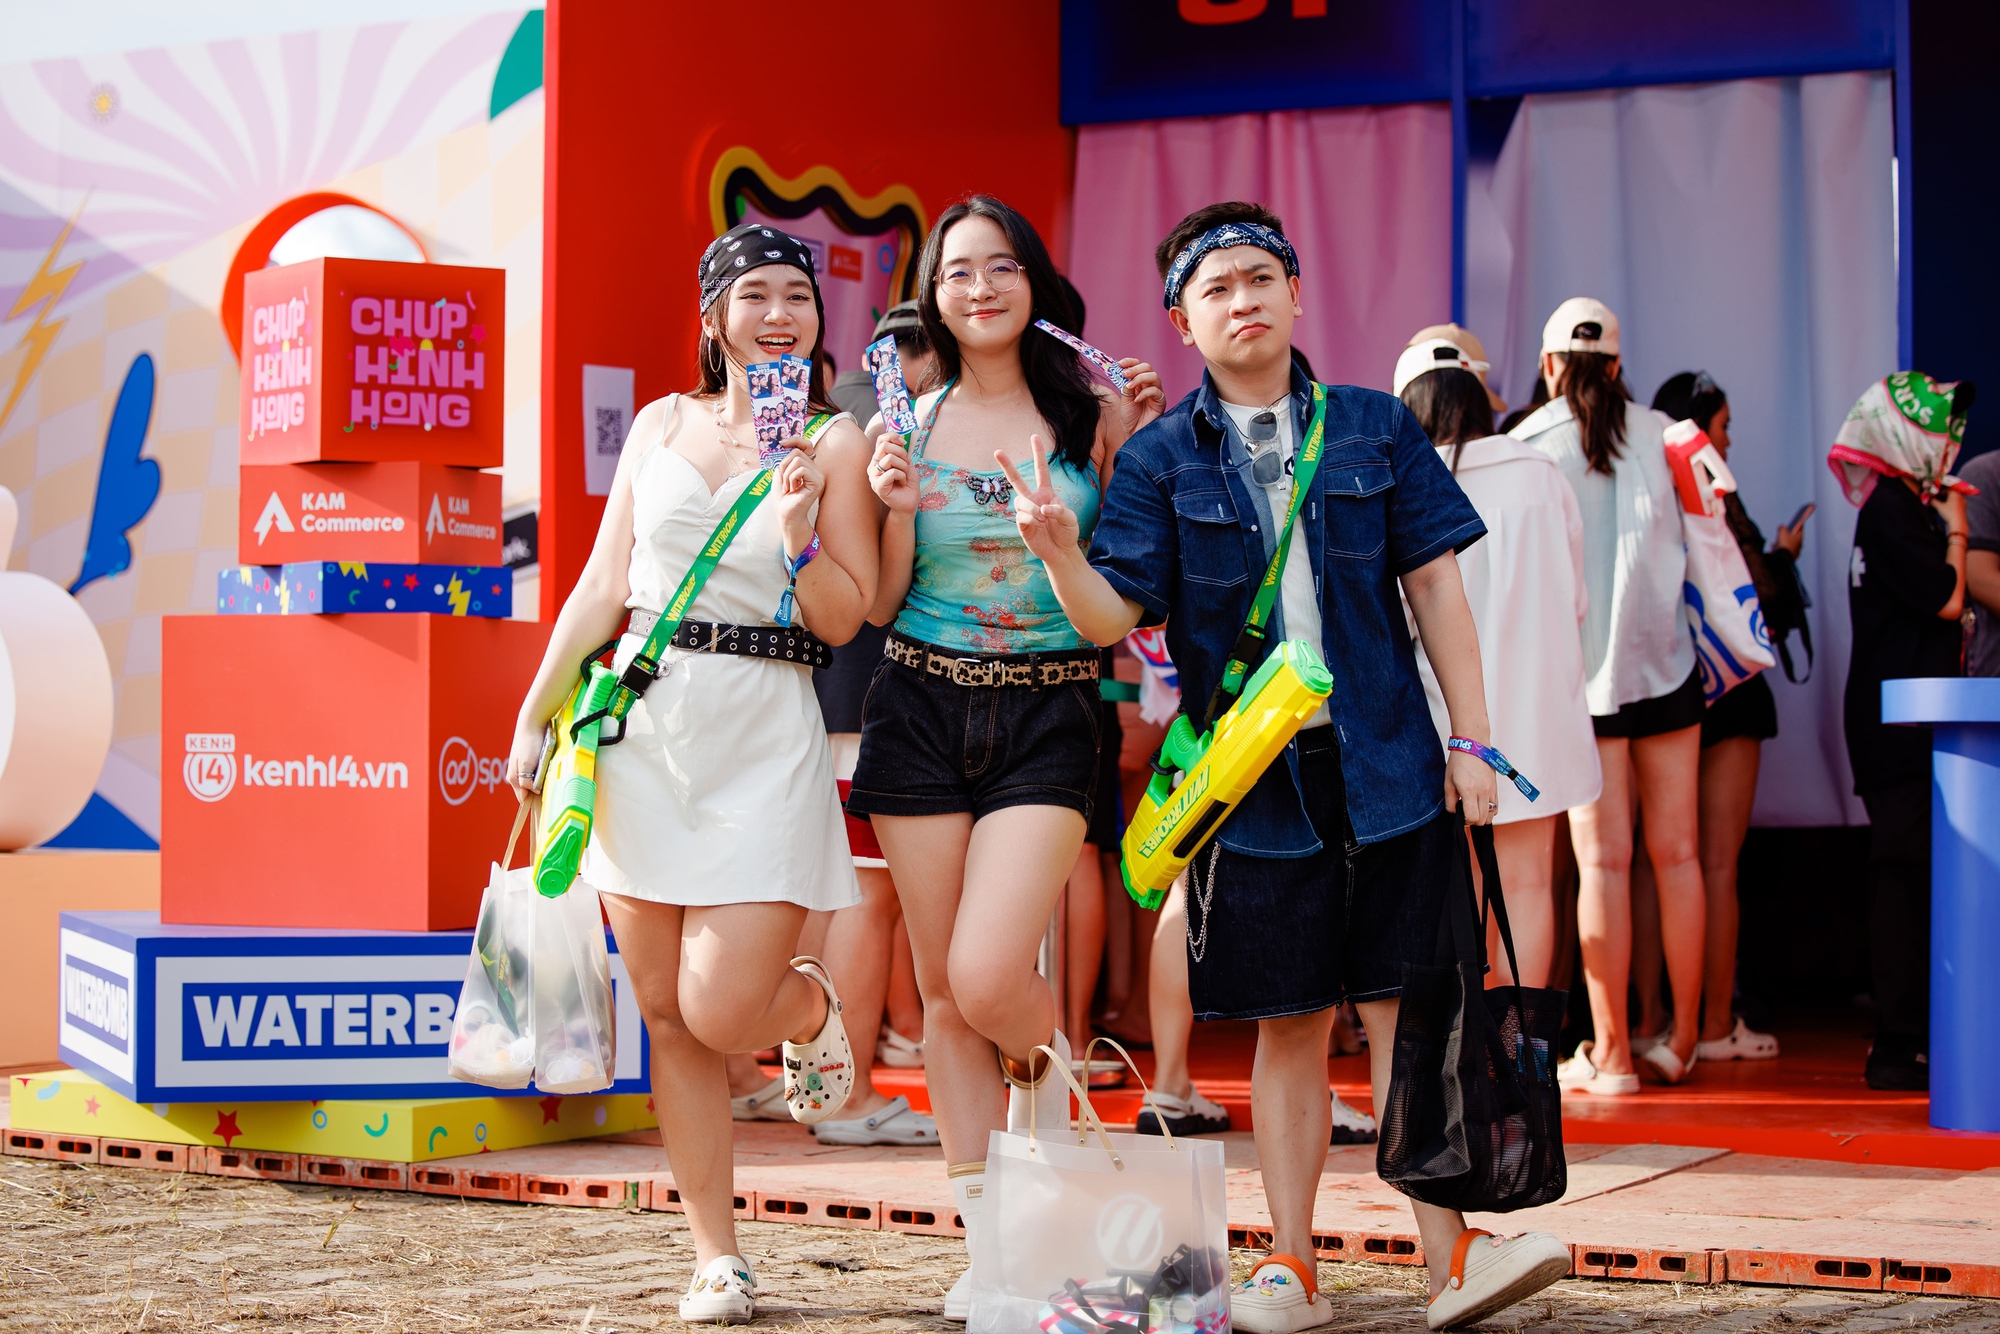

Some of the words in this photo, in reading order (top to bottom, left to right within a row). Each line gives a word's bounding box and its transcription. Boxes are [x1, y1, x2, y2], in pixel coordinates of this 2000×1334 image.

[253, 301, 305, 345] CHUP
[352, 297, 467, 340] CHUP
[351, 389, 470, 428] HONG
[301, 492, 346, 511] KAM
[447, 496, 470, 516] KAM
[301, 514, 405, 532] Commerce
[447, 518, 497, 540] Commerce
[189, 737, 232, 750] KENH
[196, 757, 224, 785] 14
[243, 753, 409, 788] kenh14.vn
[65, 963, 129, 1041] WATERBOMB
[193, 993, 458, 1048] WATERB
[819, 1062, 845, 1074] crocs
